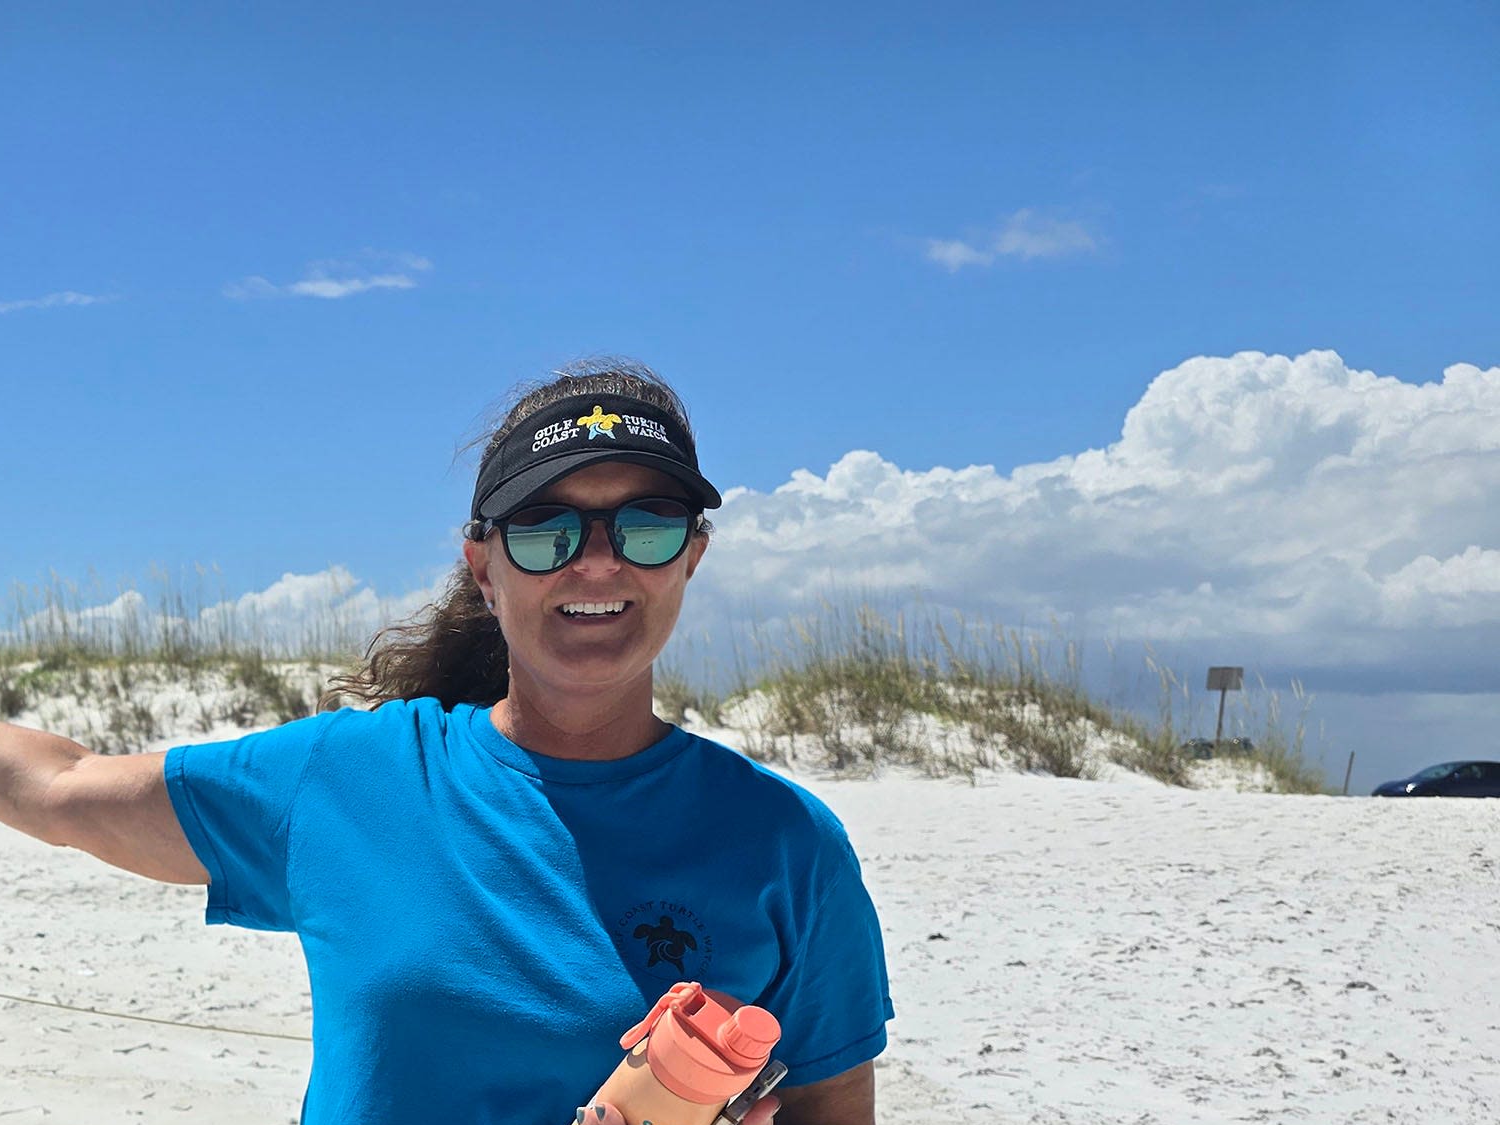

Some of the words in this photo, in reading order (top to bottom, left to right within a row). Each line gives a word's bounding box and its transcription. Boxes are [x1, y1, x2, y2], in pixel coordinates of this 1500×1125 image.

[534, 418, 573, 441] GULF
[622, 414, 666, 435] TURTLE
[626, 425, 670, 444] WATCH
[531, 428, 580, 452] COAST
[619, 901, 654, 927] COAST
